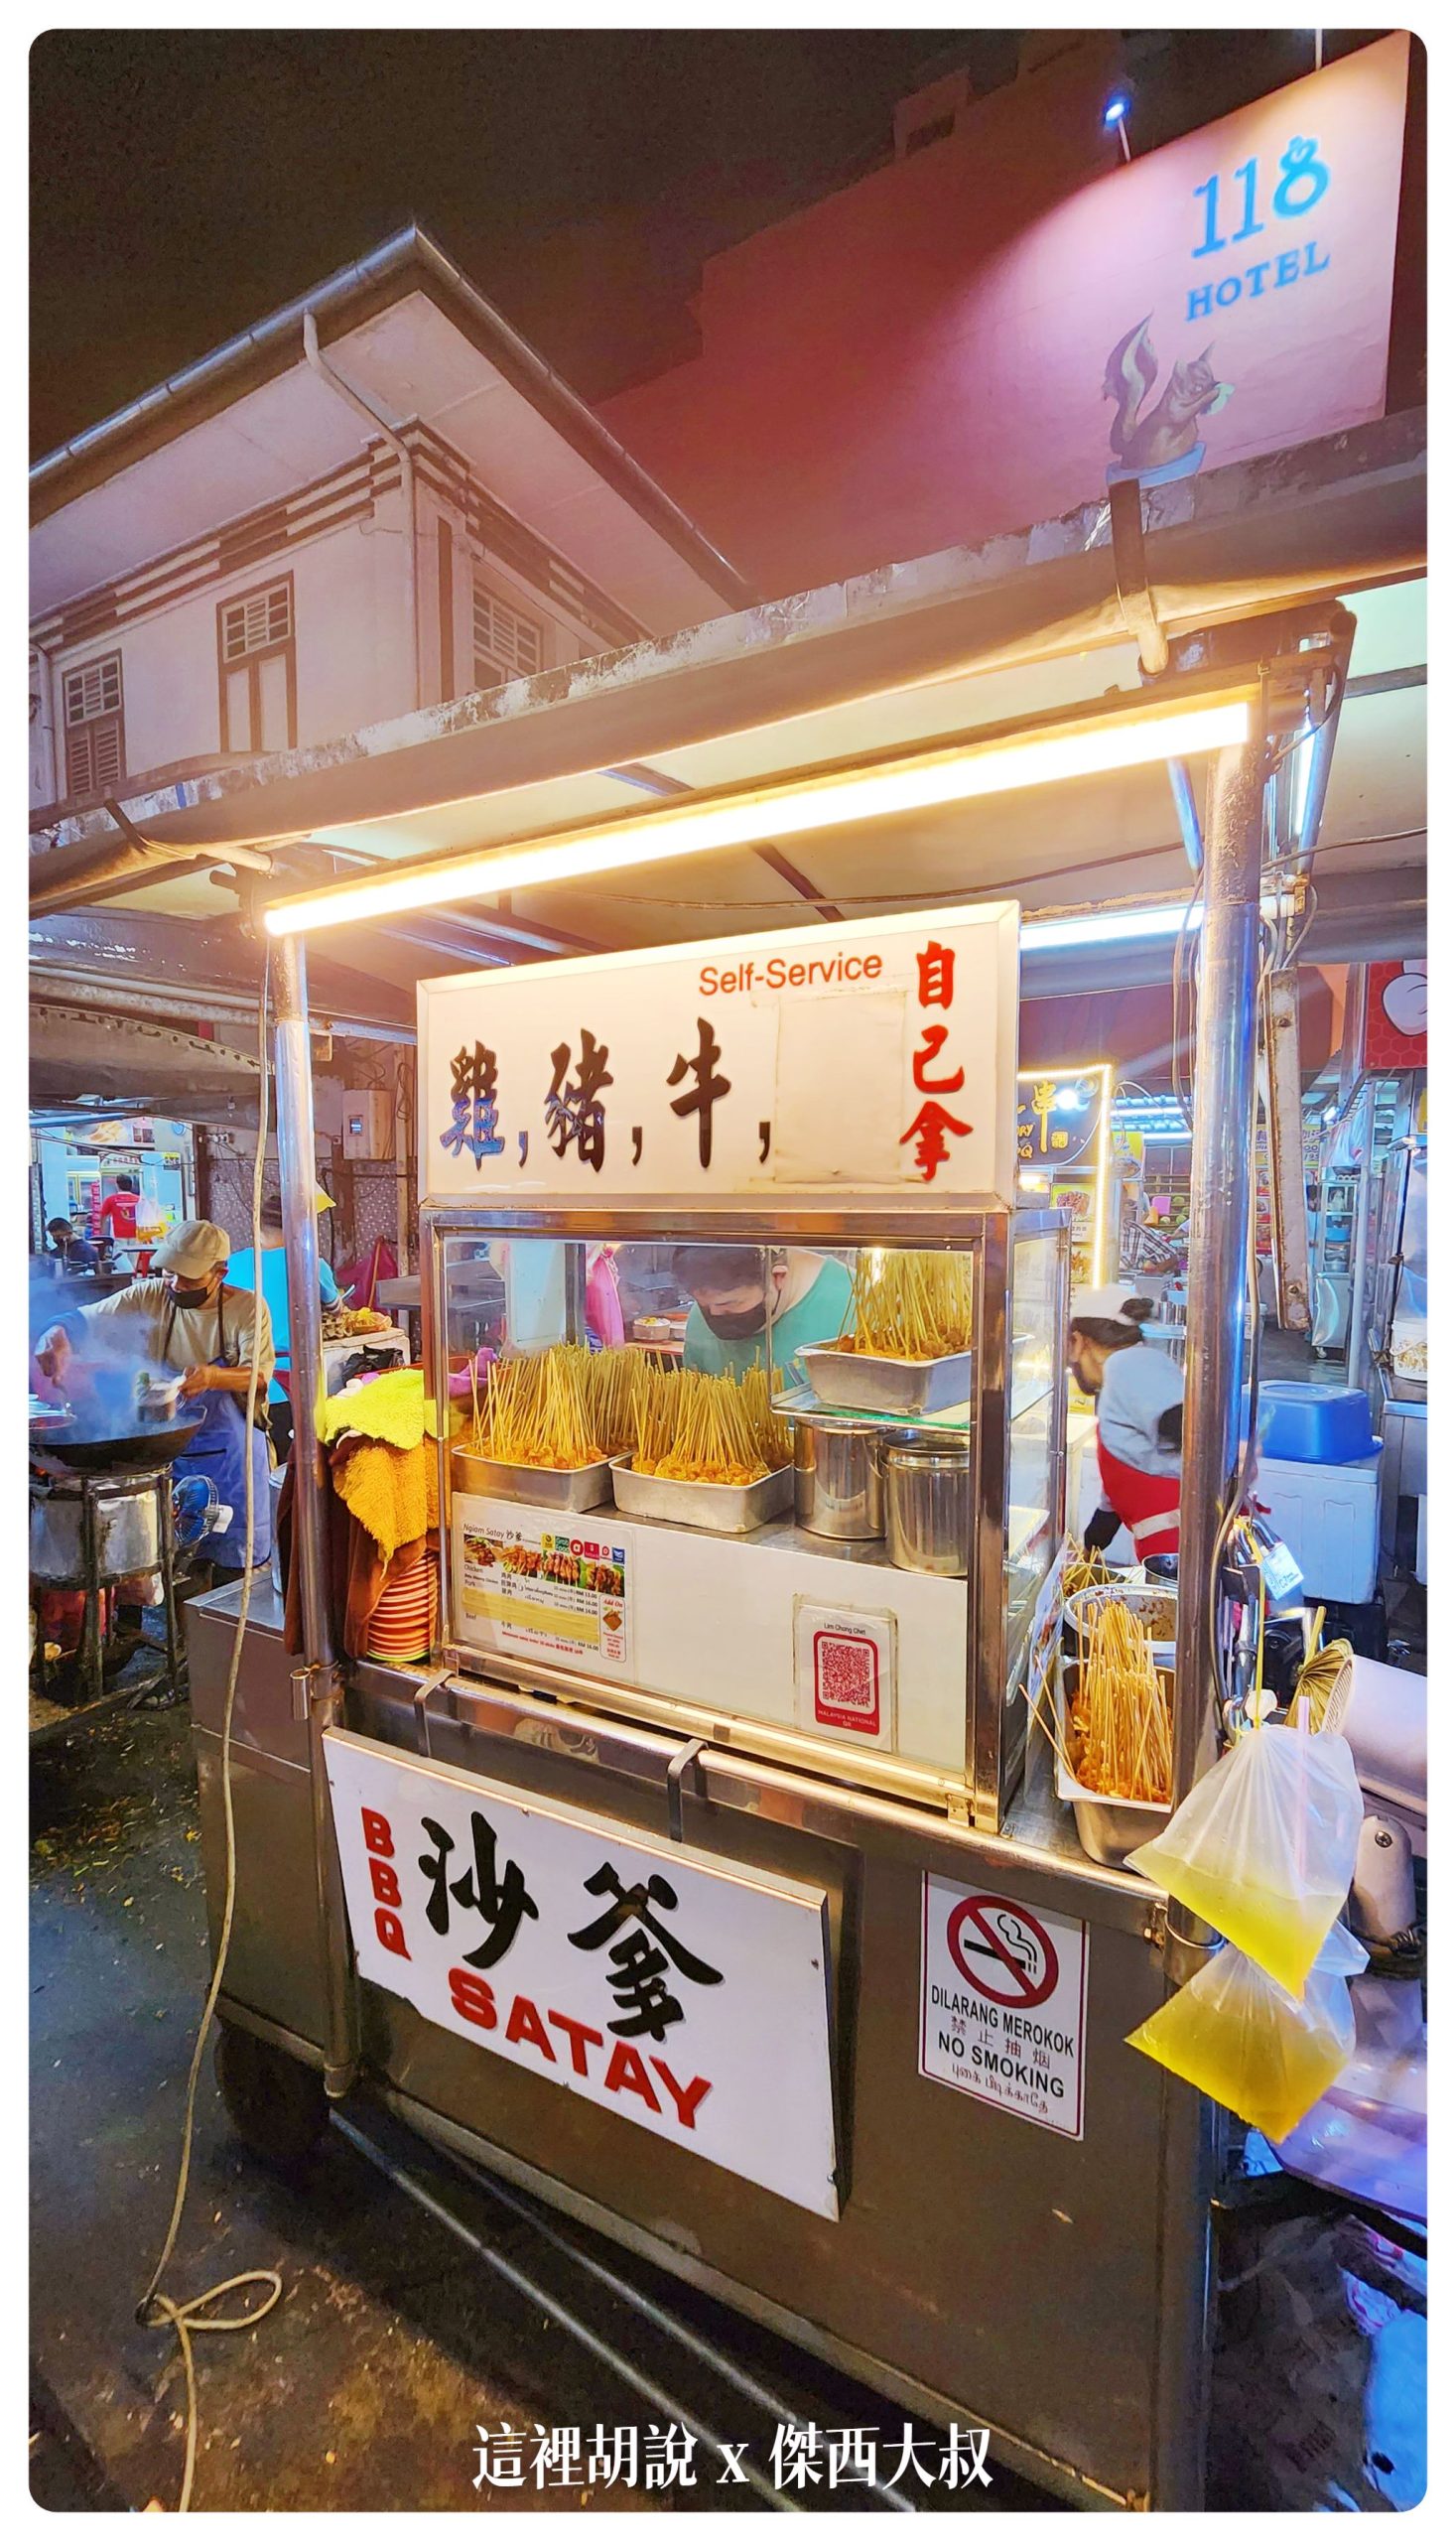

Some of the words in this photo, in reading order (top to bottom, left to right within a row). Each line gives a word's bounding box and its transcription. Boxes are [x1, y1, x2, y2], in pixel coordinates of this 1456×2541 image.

[1192, 135, 1331, 259] 118
[1185, 241, 1331, 323] HOTEL
[699, 952, 882, 997] Self-Service
[899, 940, 973, 1181] 自己拿
[486, 1528, 504, 1539] Satay
[818, 1709, 846, 1720] MALAYSIA
[847, 1715, 876, 1727] NATIONAL
[360, 1806, 412, 1961] BBQ
[417, 1810, 724, 2042] 沙爹
[448, 1966, 713, 2130] SATAY
[931, 1984, 998, 2028] DILARANG
[1002, 2011, 1074, 2058] MEROKOK
[951, 2015, 1050, 2070] 禁止抽烟
[938, 2031, 965, 2058] NO
[972, 2045, 1064, 2098] SMOKING
